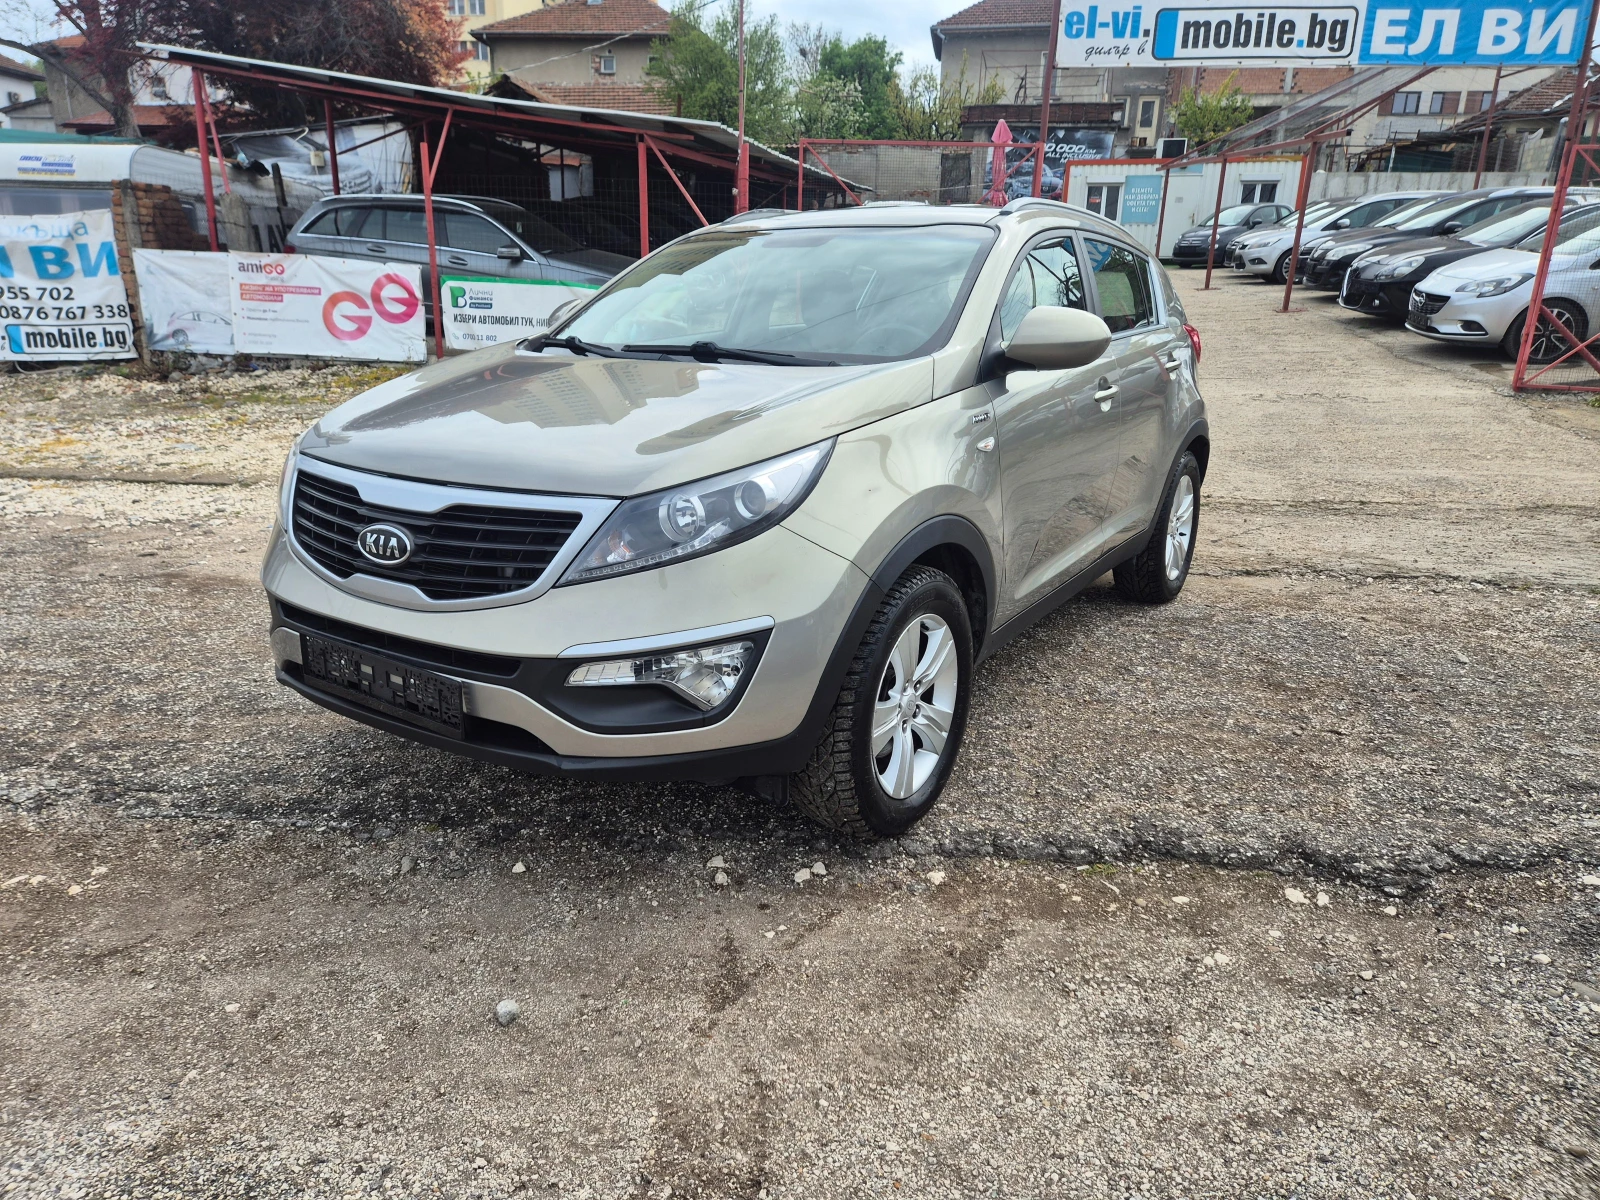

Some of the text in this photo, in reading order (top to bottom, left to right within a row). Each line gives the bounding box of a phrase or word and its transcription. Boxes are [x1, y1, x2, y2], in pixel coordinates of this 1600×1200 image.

[1064, 6, 1151, 39] el-vi.
[1180, 12, 1349, 53] mobile.bg
[1369, 8, 1579, 56] ЕЛ ВИ
[1084, 43, 1131, 61] дилър
[28, 241, 120, 280] ВИ
[36, 287, 75, 301] 702
[0, 304, 128, 320] 0876 767 338
[478, 314, 520, 326] АВТОМОБИЛ
[25, 326, 127, 349] mobile.bg
[365, 532, 400, 558] KIA
